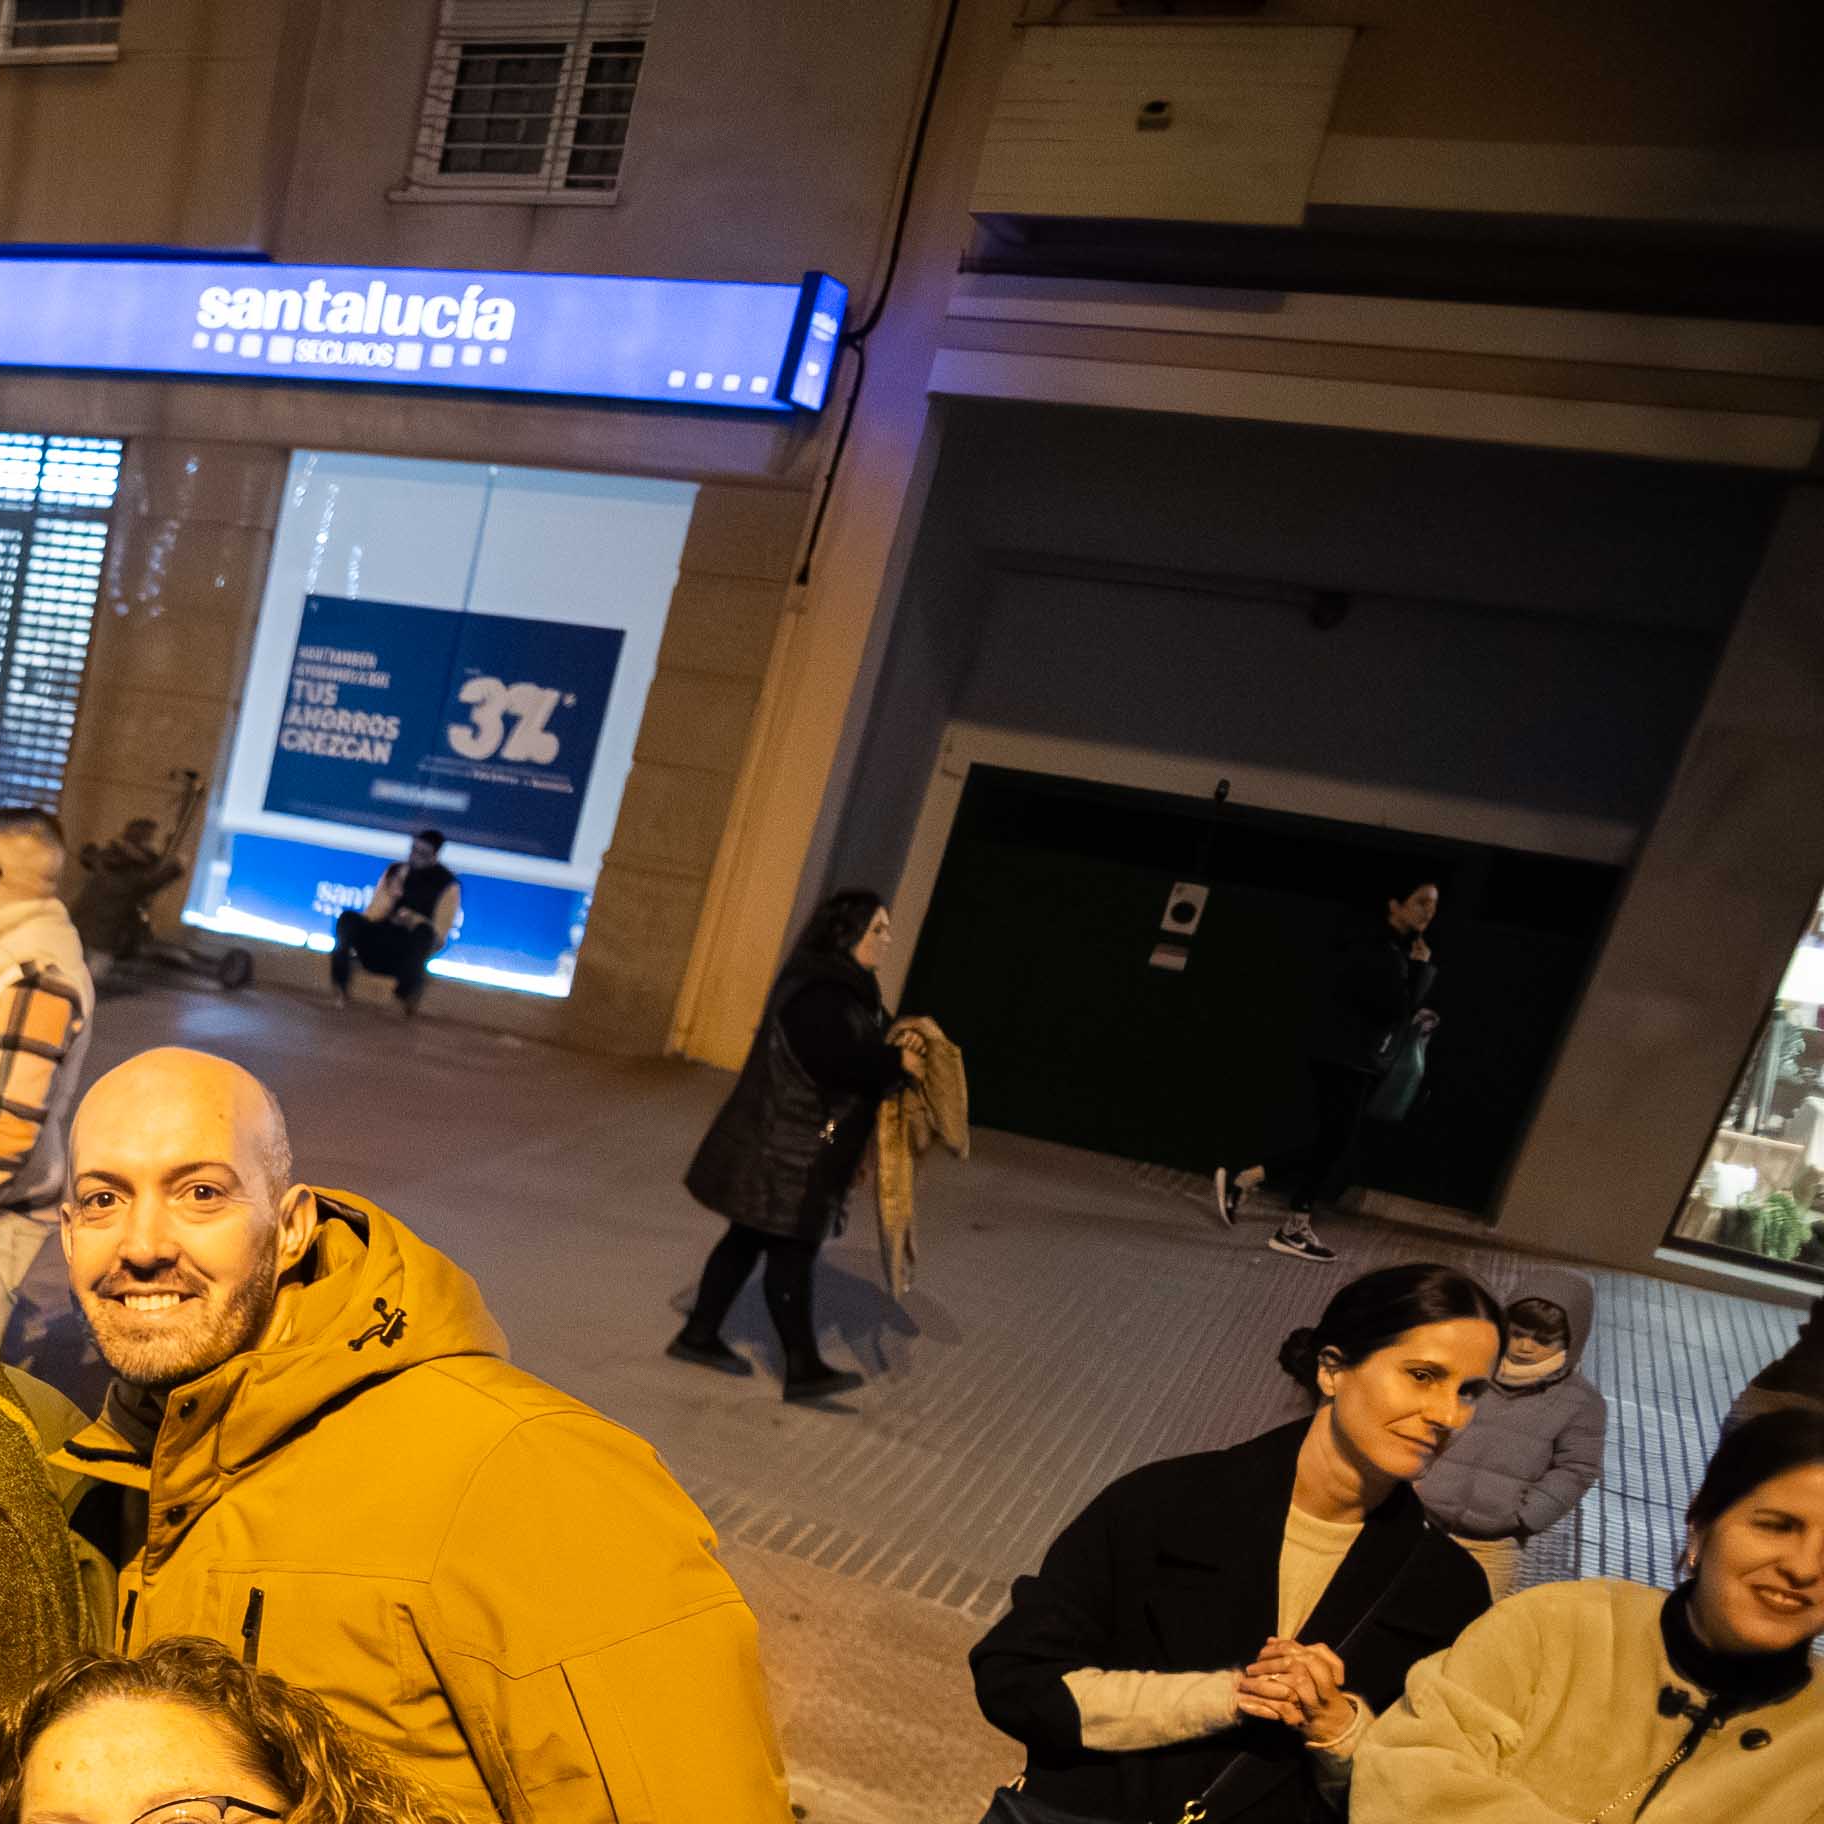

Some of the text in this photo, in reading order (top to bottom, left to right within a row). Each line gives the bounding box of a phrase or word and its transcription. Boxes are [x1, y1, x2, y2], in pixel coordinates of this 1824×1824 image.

[196, 278, 516, 341] santalucía
[295, 338, 395, 367] SEGUROS
[292, 678, 340, 706] TUS
[286, 703, 401, 742] AHORROS
[279, 728, 394, 766] CREZCAN
